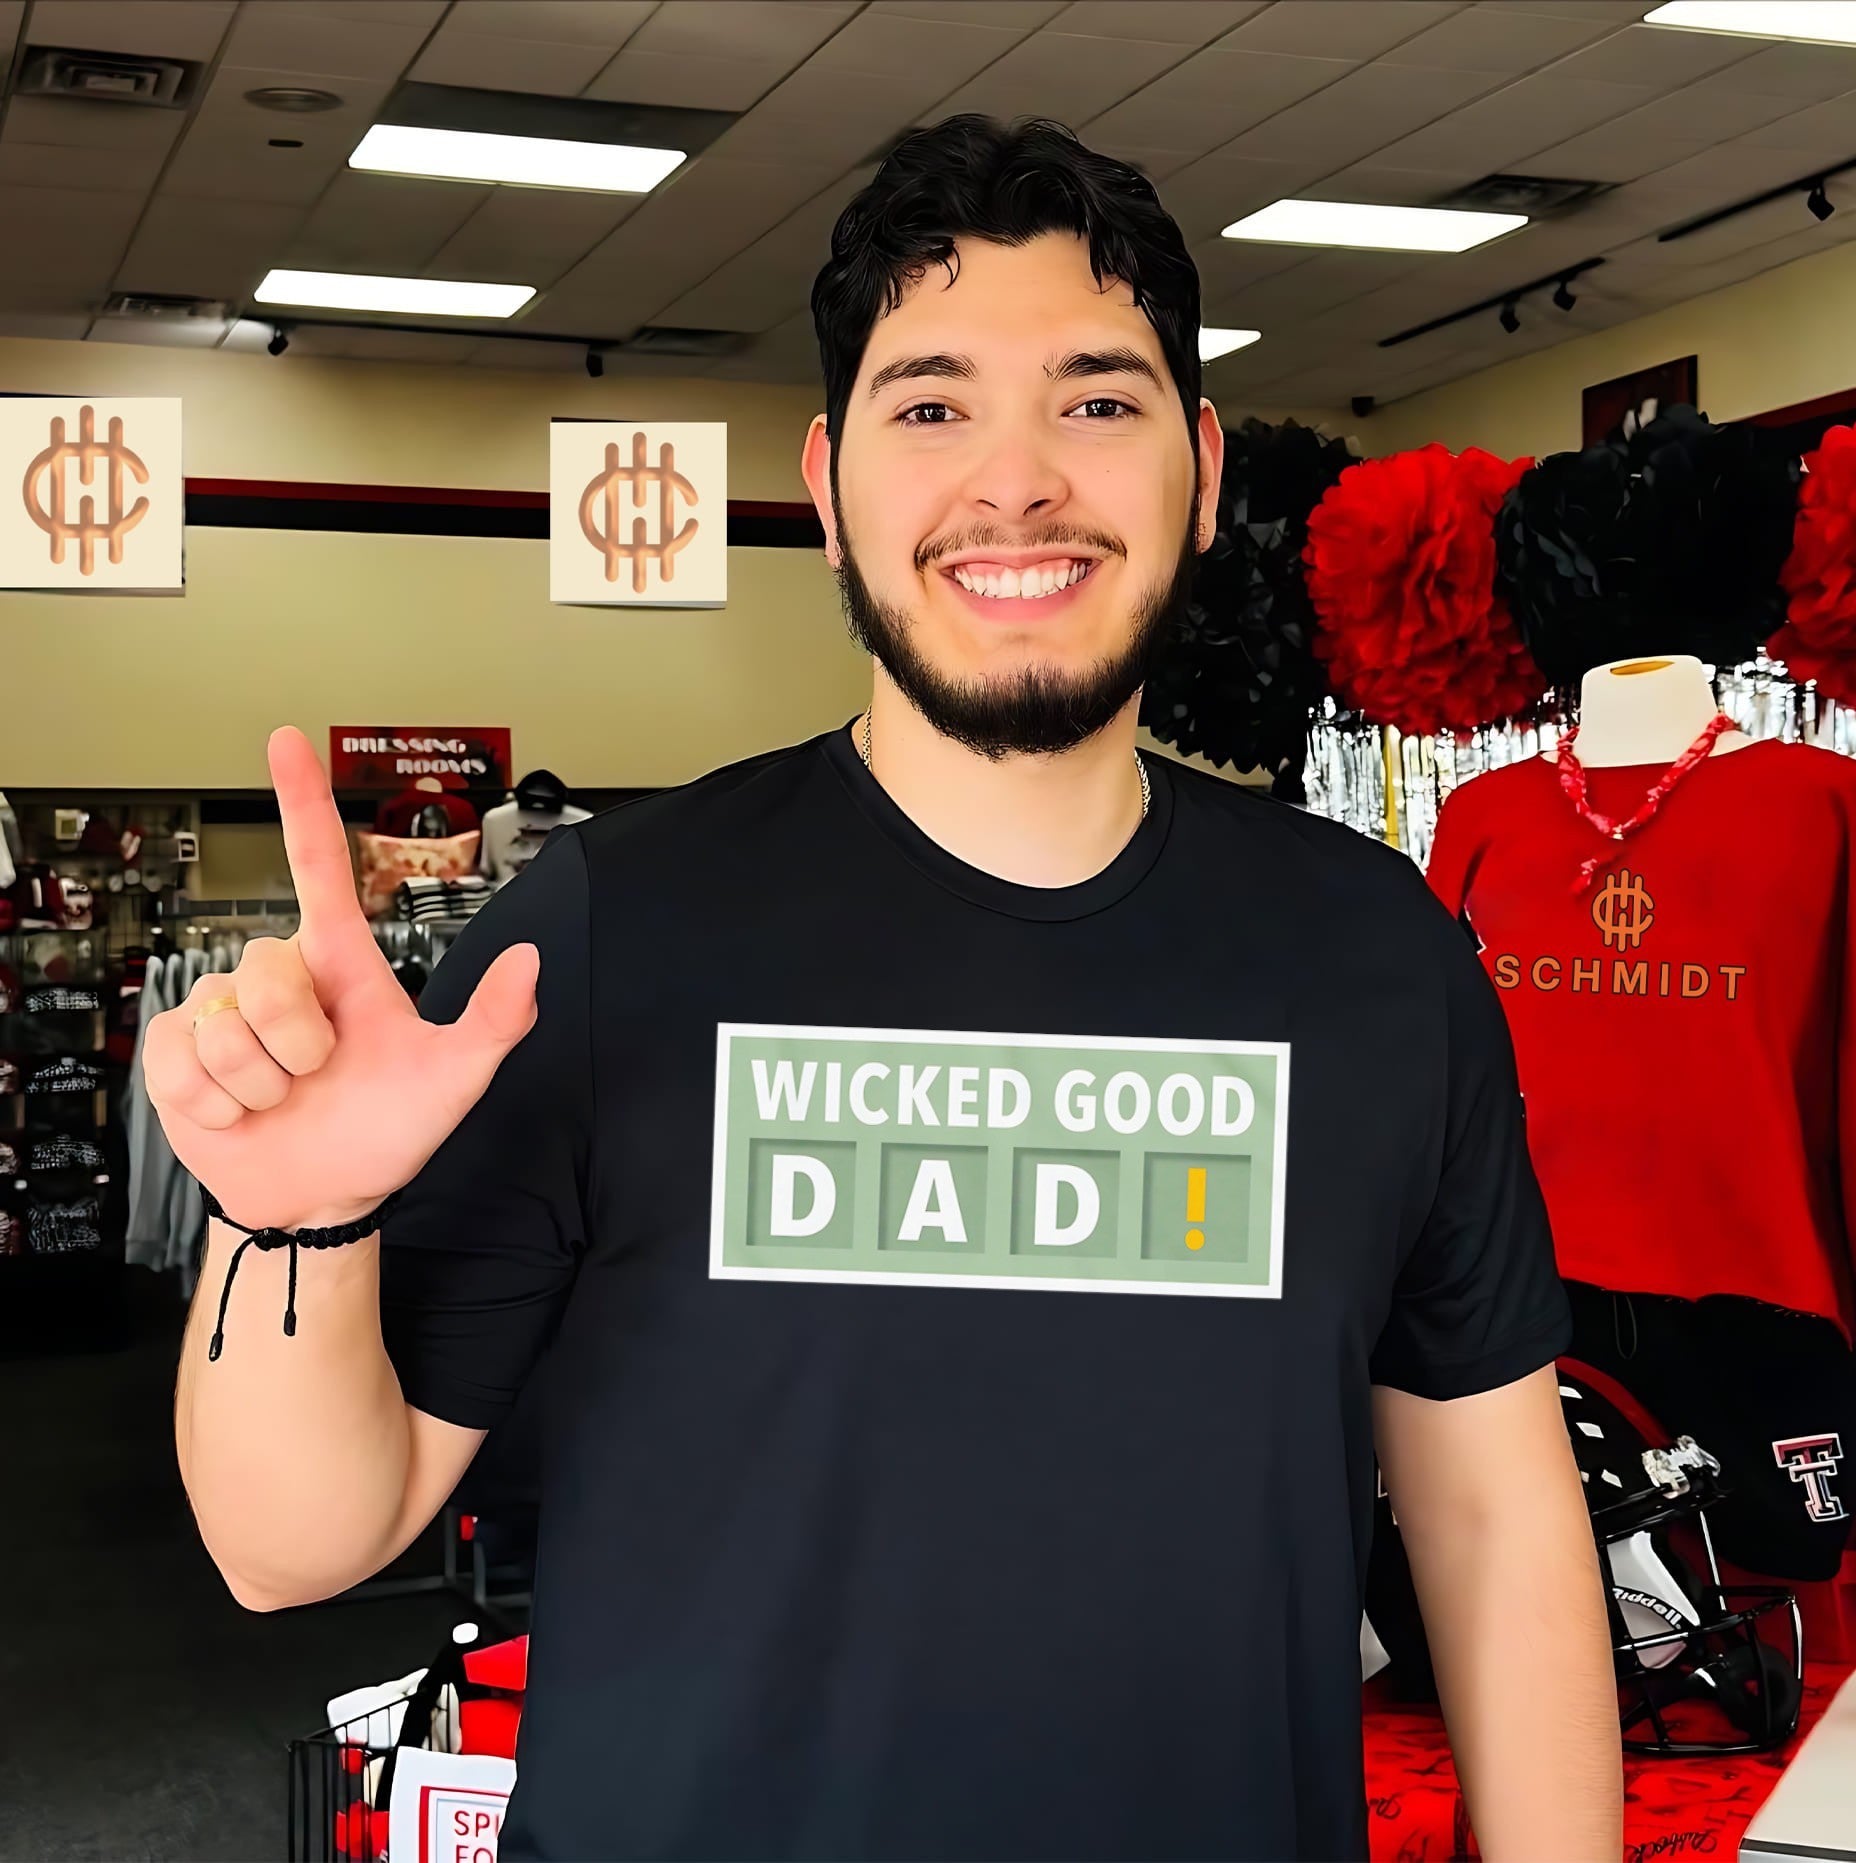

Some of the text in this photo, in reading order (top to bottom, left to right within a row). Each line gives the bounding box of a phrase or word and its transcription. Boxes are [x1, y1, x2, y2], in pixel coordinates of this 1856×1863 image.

[342, 737, 466, 754] DRESSING
[396, 758, 487, 775] ROOMS
[1494, 953, 1747, 1000] SCHMIDT
[750, 1058, 1256, 1138] WICKED GOOD
